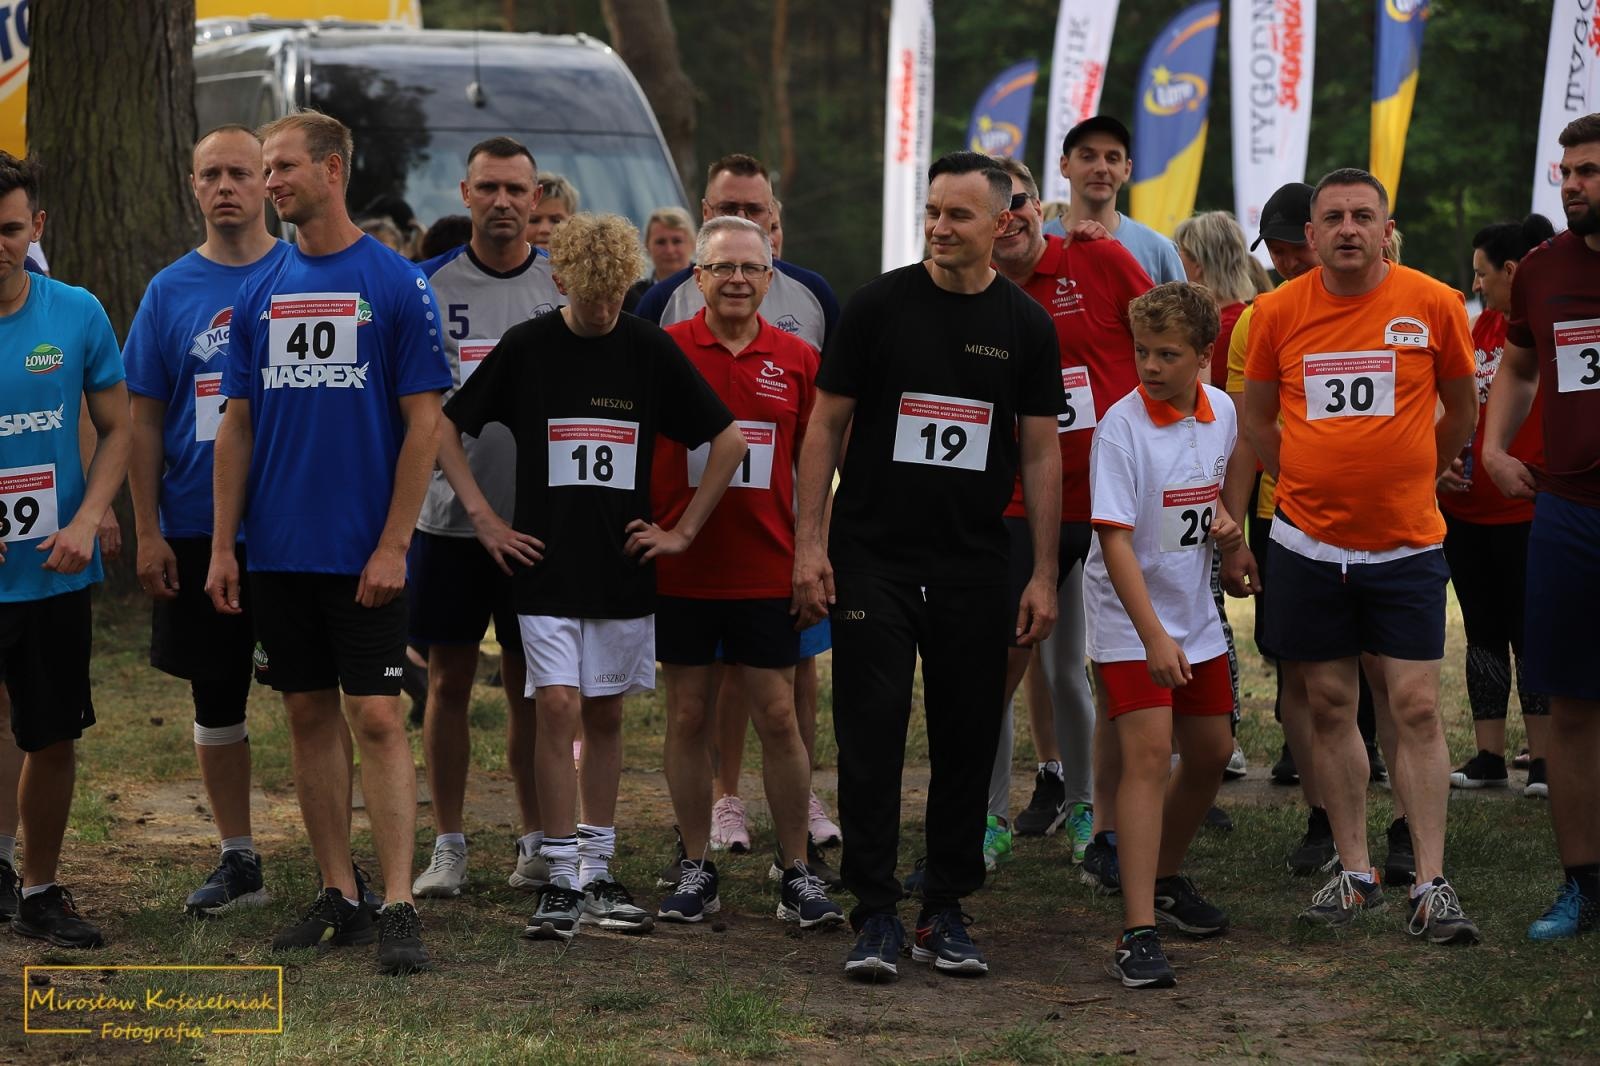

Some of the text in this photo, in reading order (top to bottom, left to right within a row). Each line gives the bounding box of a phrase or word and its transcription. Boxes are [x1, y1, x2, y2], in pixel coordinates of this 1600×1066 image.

[448, 304, 469, 340] 5
[287, 322, 336, 360] 40
[965, 344, 1009, 360] MIESZKO
[26, 354, 64, 366] ŁOWICZ
[262, 365, 364, 389] MASPEX
[590, 398, 634, 410] MIESZKO
[1325, 376, 1374, 412] 30
[920, 423, 967, 461] 19
[572, 444, 614, 482] 18
[1180, 507, 1212, 546] 29
[384, 667, 403, 676] JAKO
